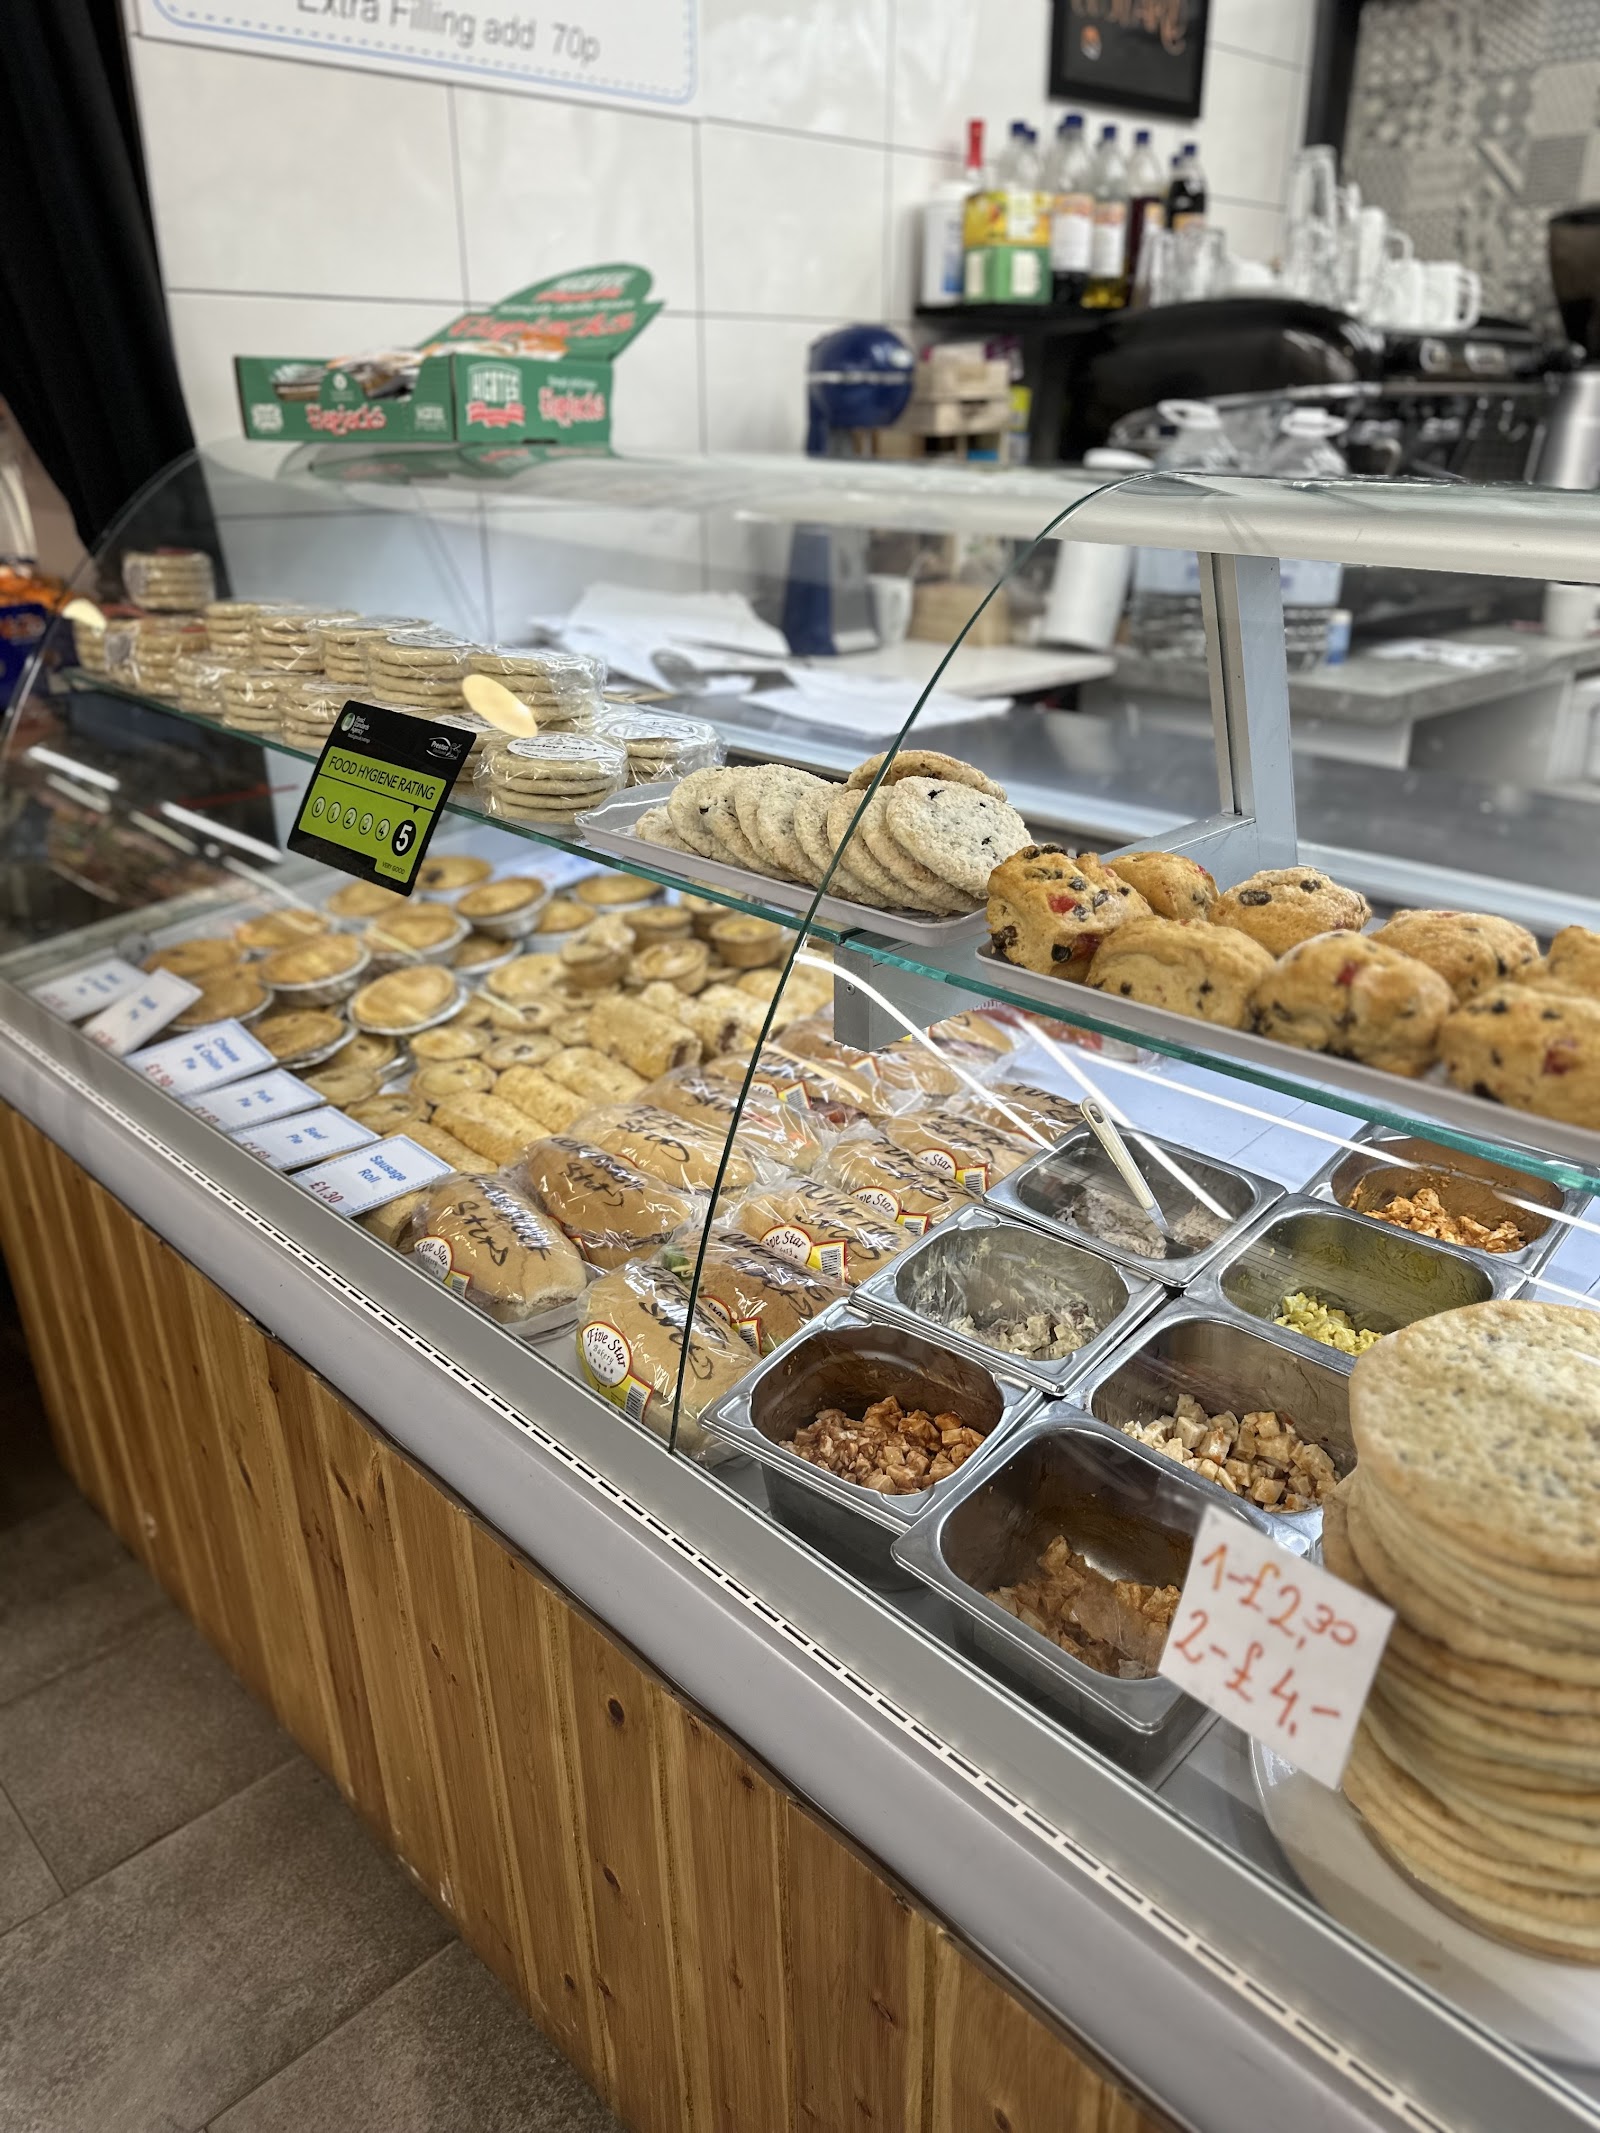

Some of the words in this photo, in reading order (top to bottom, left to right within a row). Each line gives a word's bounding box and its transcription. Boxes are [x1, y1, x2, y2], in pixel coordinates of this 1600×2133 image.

[390, 1, 476, 49] Filling
[483, 17, 537, 51] add
[550, 22, 601, 67] 70p
[328, 755, 358, 775] FOOD
[357, 764, 400, 791] HYGIENE
[397, 777, 436, 800] RATING
[395, 824, 413, 852] 5
[381, 861, 394, 871] VERY
[391, 864, 406, 875] GOOD
[201, 1049, 223, 1072] Onion
[213, 1037, 240, 1063] Cheese
[182, 1057, 197, 1071] Pie
[236, 1097, 253, 1108] Pie
[285, 1133, 303, 1145] Pie
[303, 1126, 330, 1142] Beef
[370, 1154, 407, 1183] Sausage
[929, 1153, 953, 1172] Star
[357, 1167, 381, 1184] Roll
[308, 1180, 344, 1205] £1.30
[872, 1192, 896, 1215] Star
[782, 1229, 807, 1253] Star
[434, 1243, 449, 1266] Star
[586, 1326, 609, 1347] Five
[608, 1338, 627, 1369] Star
[592, 1344, 616, 1366] Bakery
